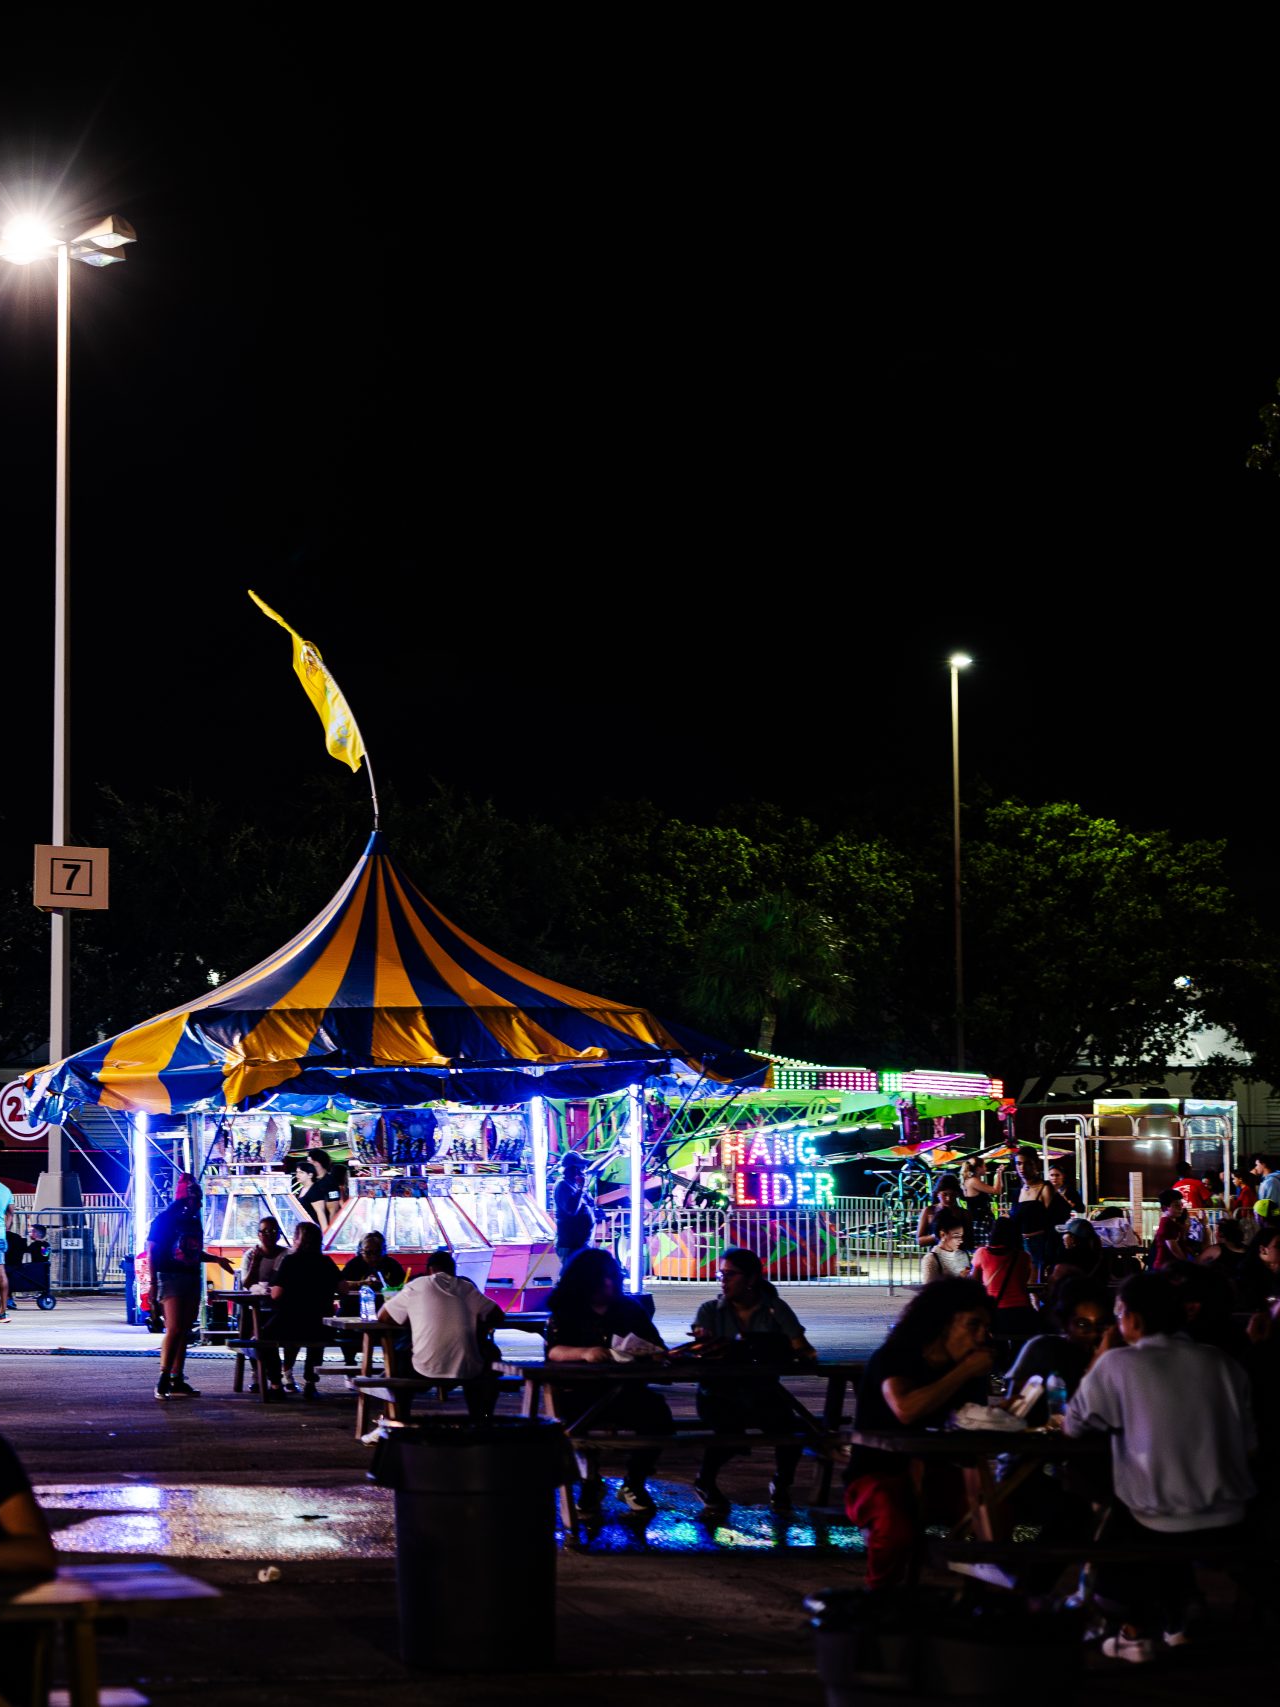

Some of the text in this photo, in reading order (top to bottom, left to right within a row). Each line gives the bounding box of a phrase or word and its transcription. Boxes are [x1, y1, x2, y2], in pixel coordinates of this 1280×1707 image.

[62, 864, 81, 890] 7
[7, 1096, 27, 1122] 2
[722, 1131, 816, 1165] HANG
